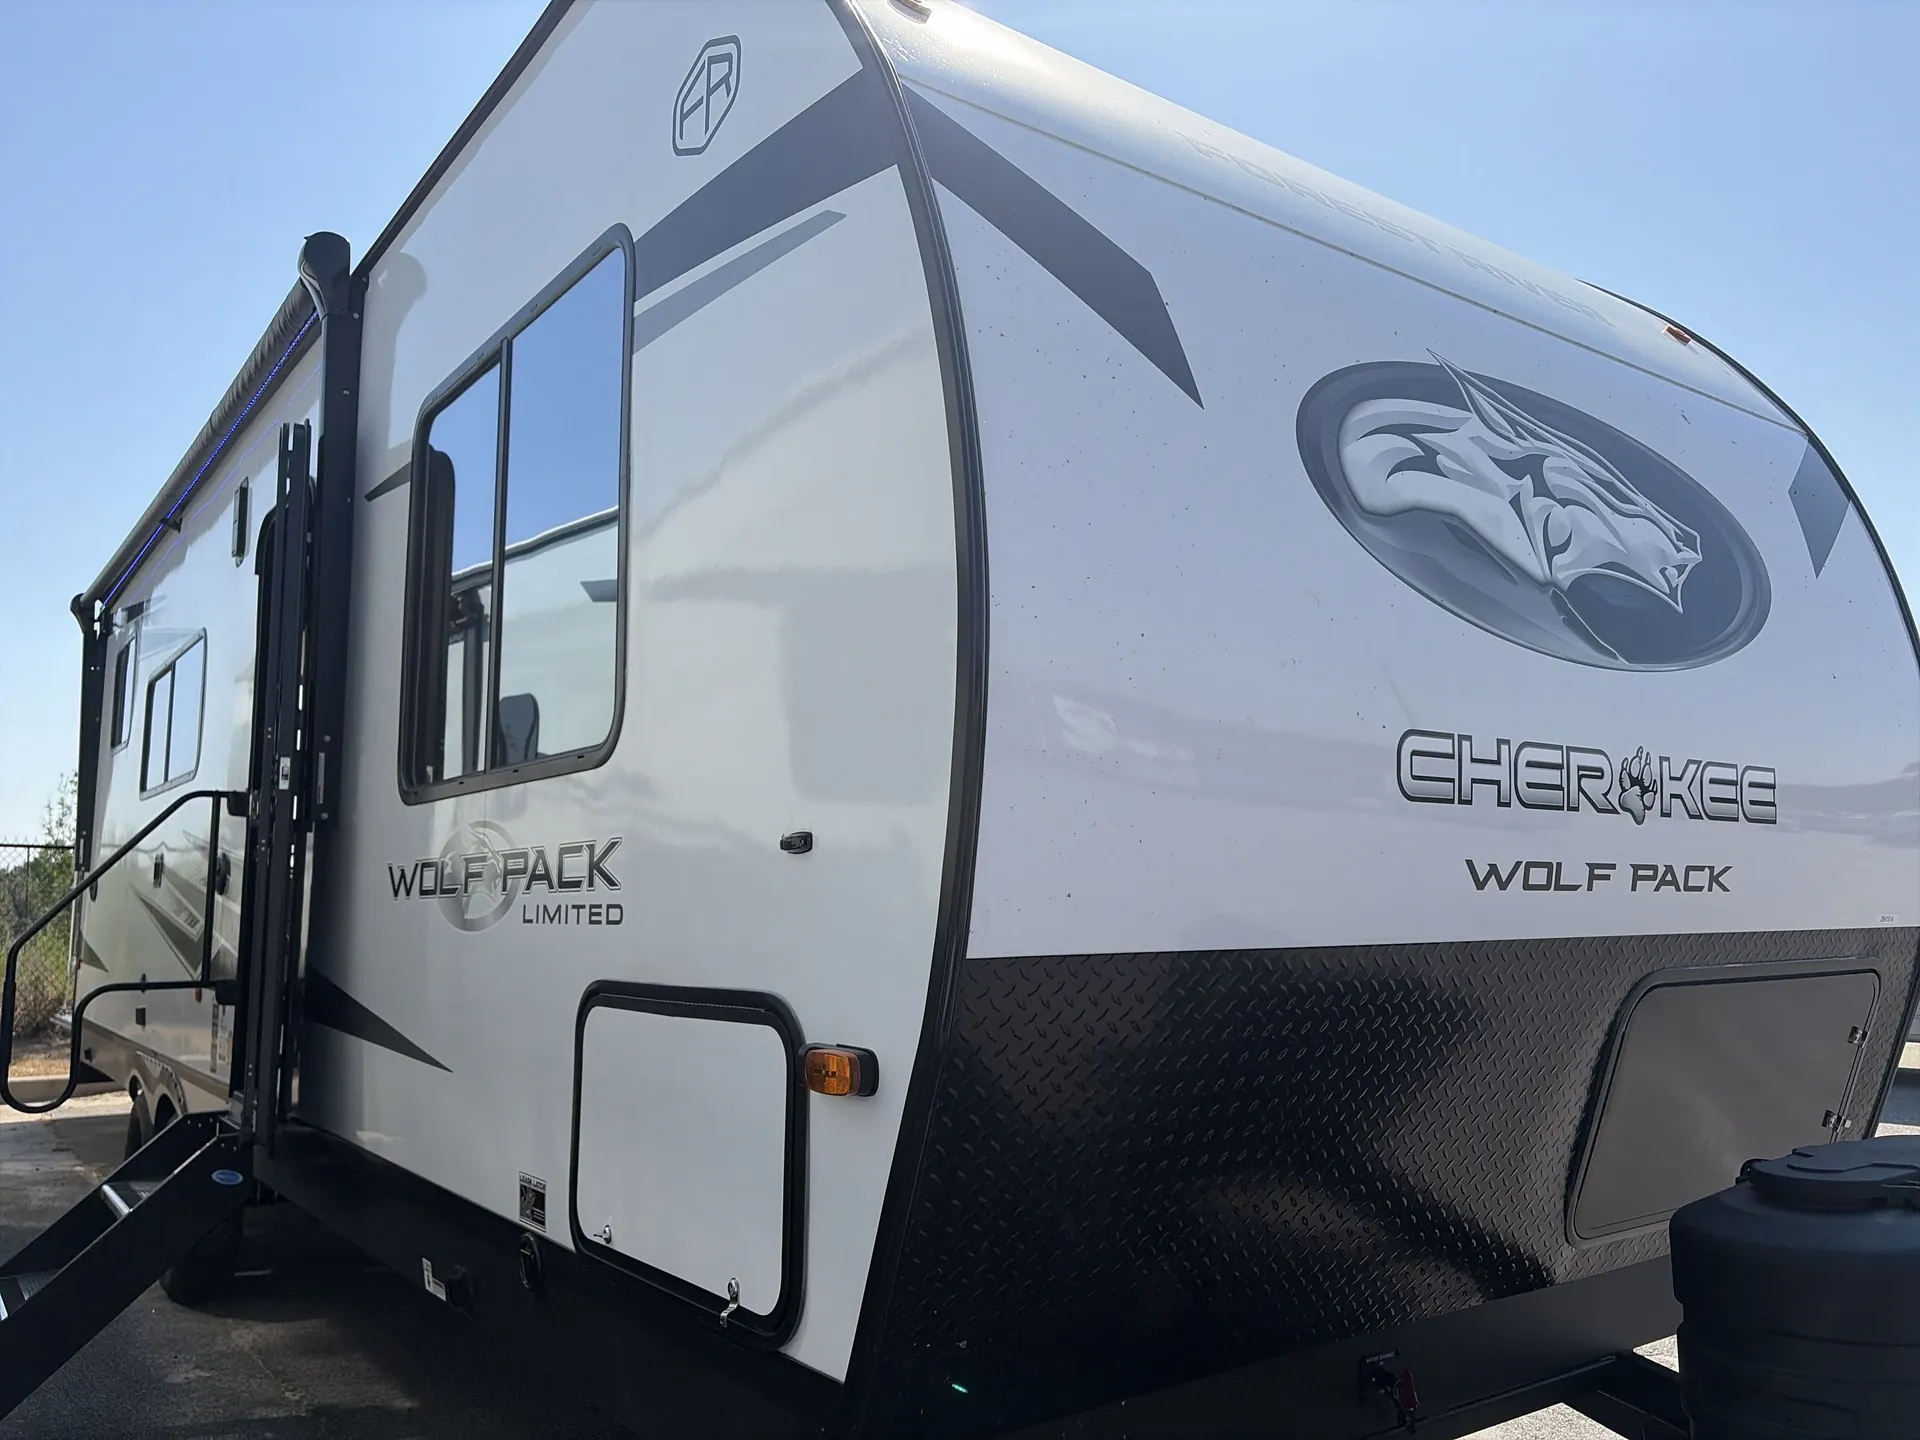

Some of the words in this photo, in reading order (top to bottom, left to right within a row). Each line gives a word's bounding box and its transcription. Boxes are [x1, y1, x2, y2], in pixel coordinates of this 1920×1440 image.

[387, 852, 489, 901] WOLF
[497, 837, 623, 896] PACK
[1465, 859, 1616, 892] WOLF
[1629, 863, 1733, 893] PACK
[522, 903, 624, 926] LIMITED
